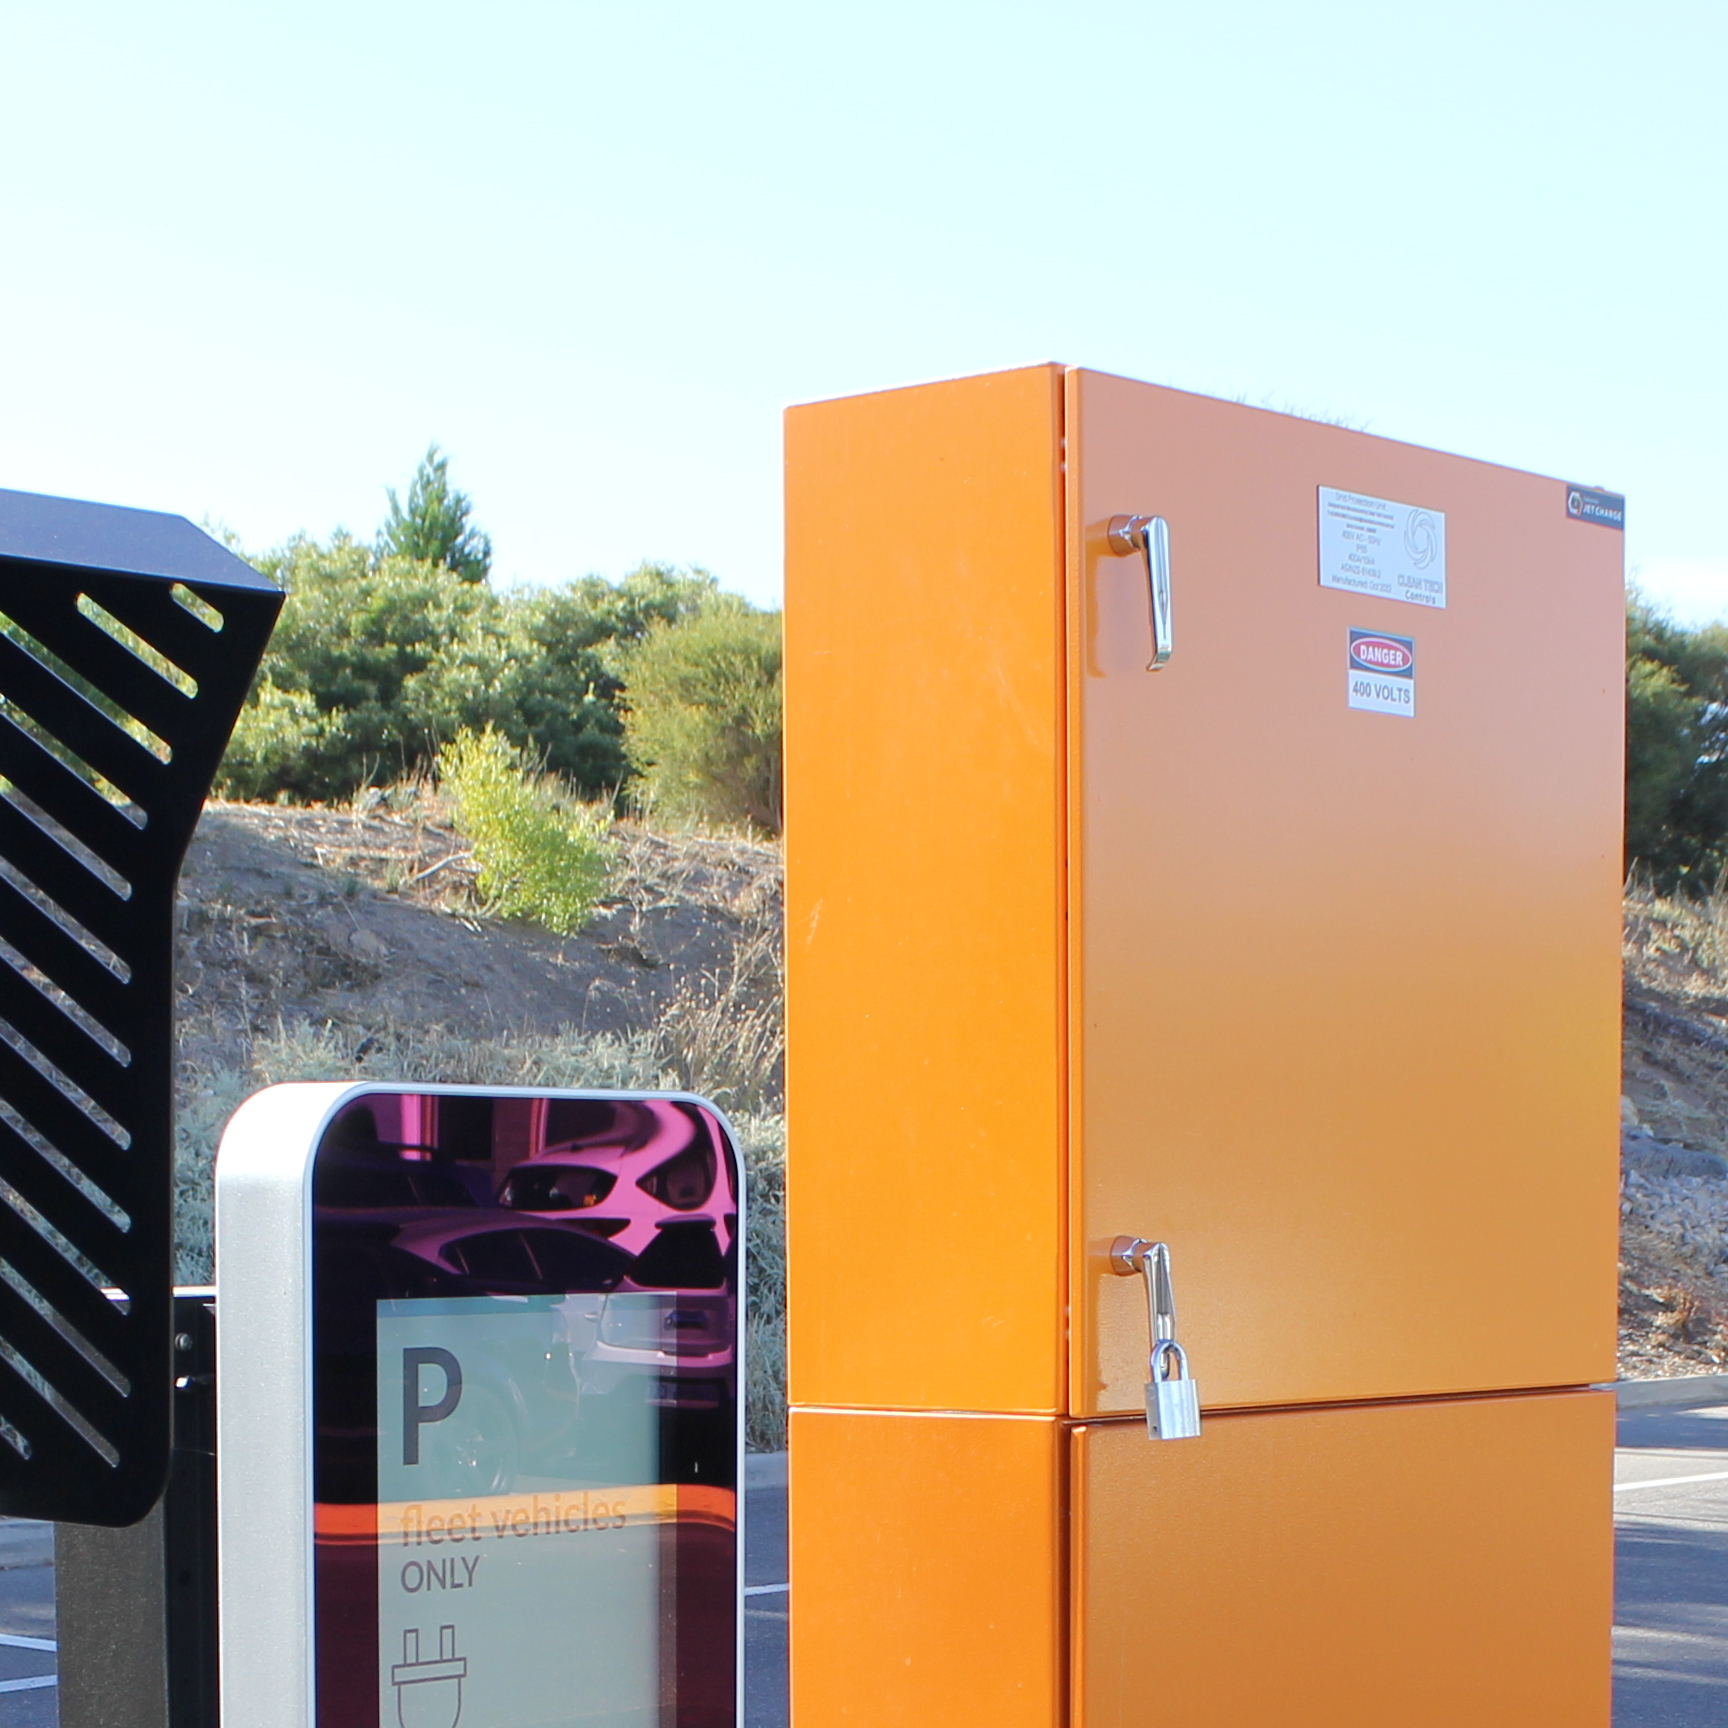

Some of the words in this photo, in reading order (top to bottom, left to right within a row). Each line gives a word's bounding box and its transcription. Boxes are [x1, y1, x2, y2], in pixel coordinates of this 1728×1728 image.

[1405, 589, 1436, 605] Controls
[1359, 644, 1404, 667] DANGER
[1352, 680, 1372, 698] 400
[1374, 683, 1411, 705] VOLTS
[402, 1346, 463, 1466] P
[400, 1503, 482, 1547] fleet
[490, 1491, 627, 1540] vehicles
[400, 1555, 480, 1593] ONLY
